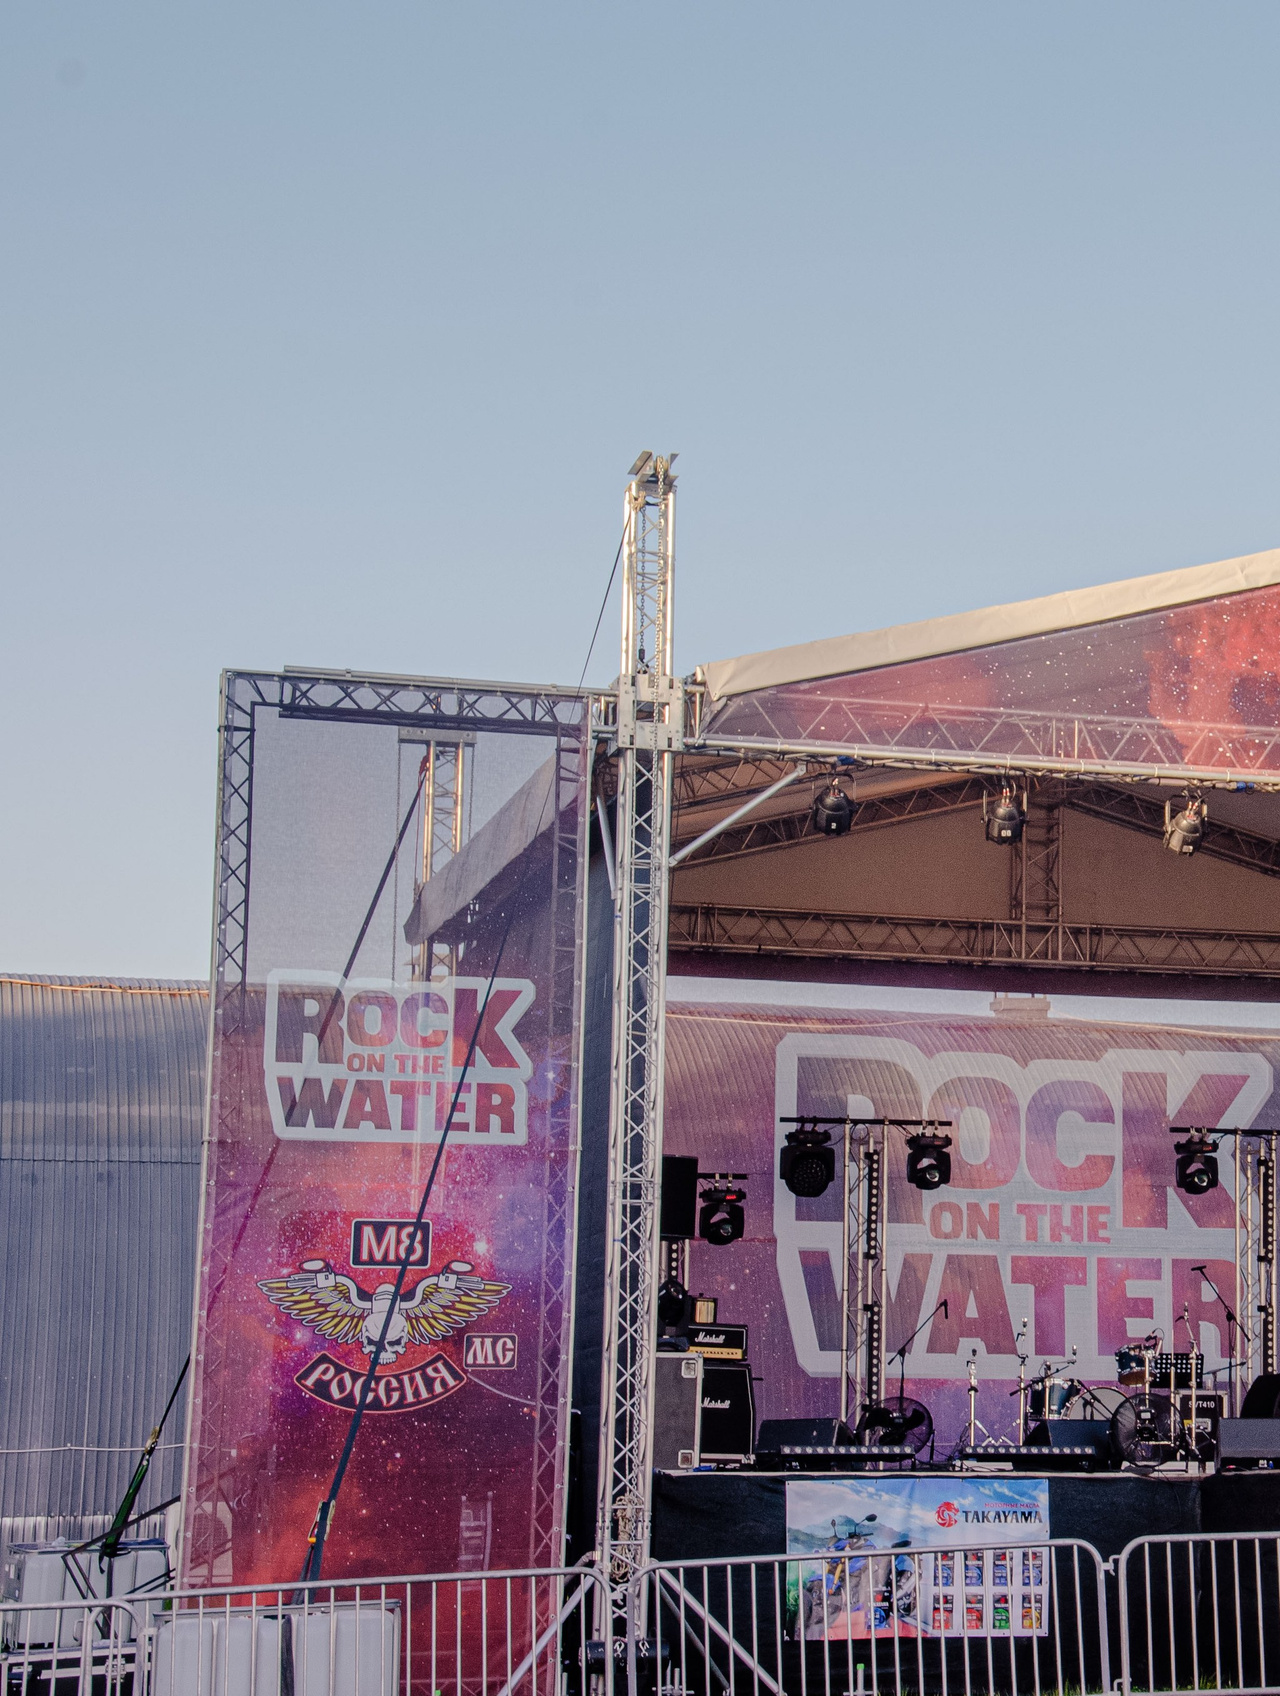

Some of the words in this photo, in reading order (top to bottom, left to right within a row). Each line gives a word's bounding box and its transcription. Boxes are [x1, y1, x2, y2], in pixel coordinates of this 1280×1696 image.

[275, 982, 524, 1070] ROCK
[346, 1052, 385, 1073] ON
[394, 1053, 445, 1075] THE
[276, 1076, 516, 1134] WATER
[795, 1055, 1252, 1230] ROCK
[361, 1225, 424, 1263] M8
[929, 1202, 1000, 1241] ON
[1016, 1204, 1111, 1244] THE
[798, 1249, 1246, 1359] WATER
[695, 1332, 725, 1343] Marshall
[301, 1360, 459, 1407] РОССИЯ
[701, 1397, 731, 1409] Marshall
[962, 1510, 1043, 1524] TAKAYAMA
